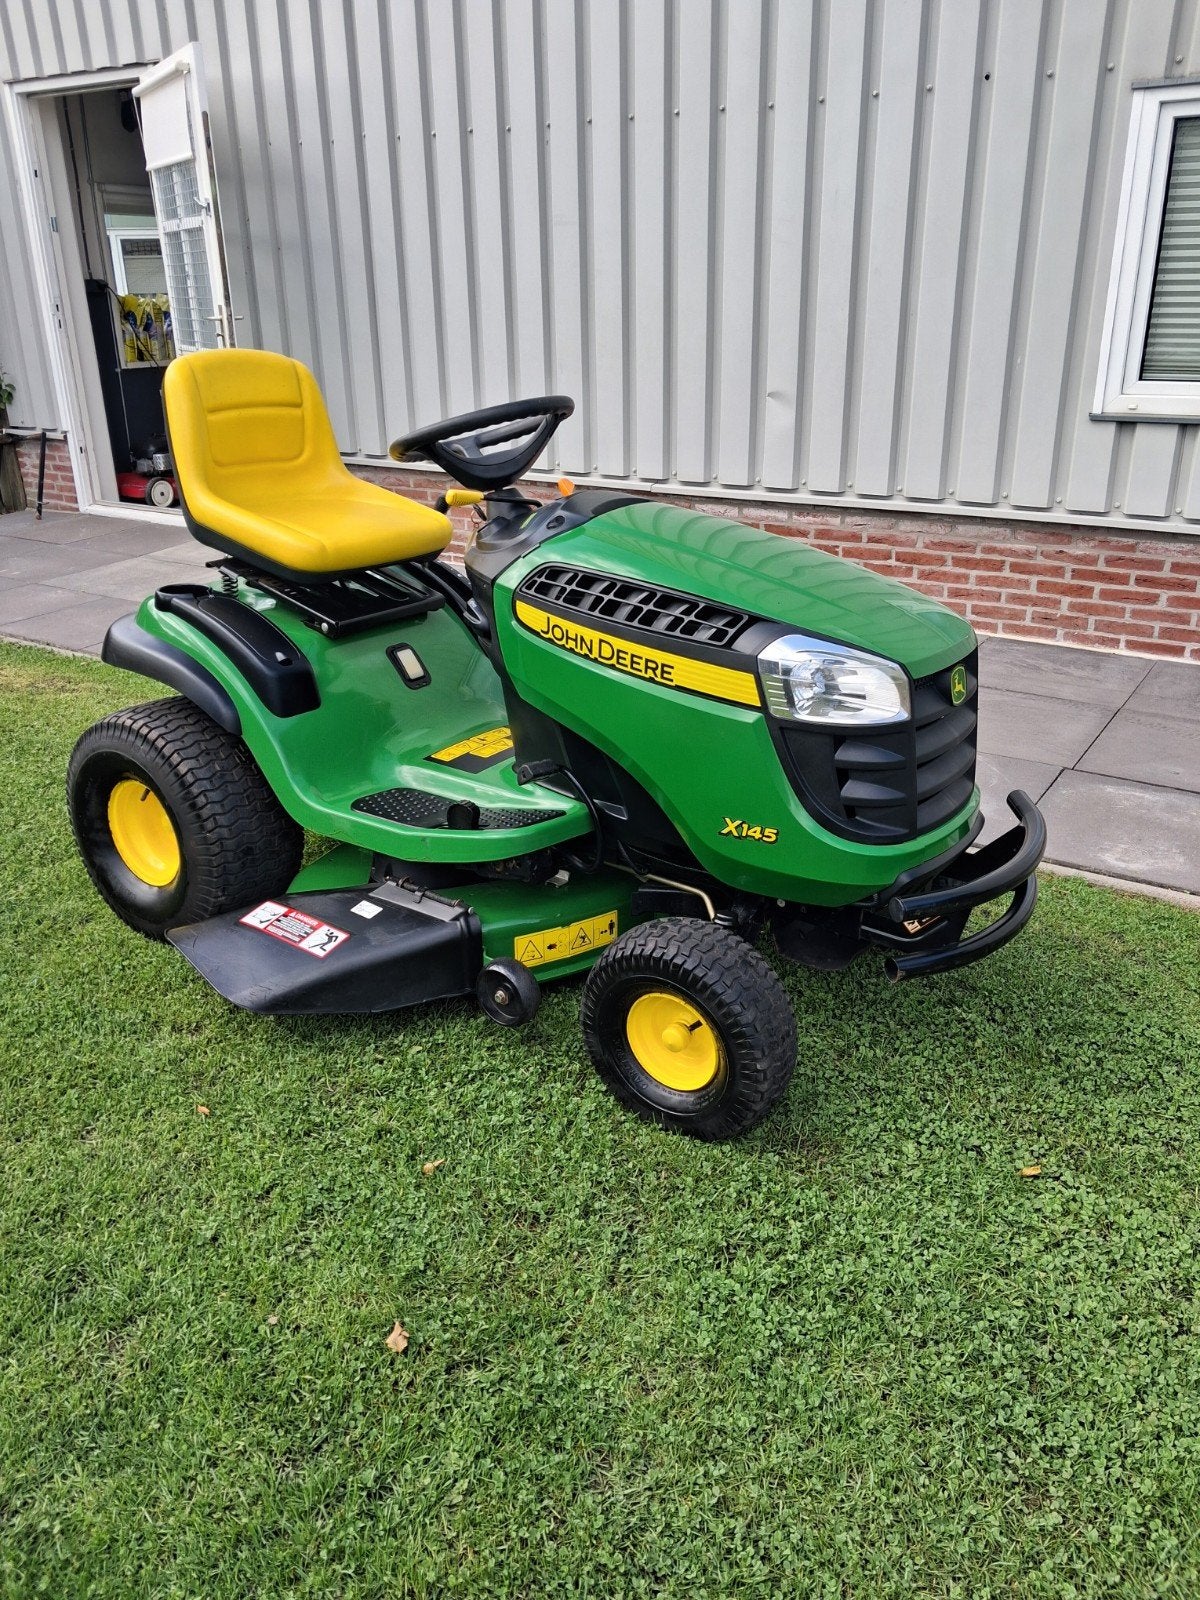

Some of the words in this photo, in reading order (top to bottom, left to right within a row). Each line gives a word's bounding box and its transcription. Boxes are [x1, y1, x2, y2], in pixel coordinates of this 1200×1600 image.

[540, 616, 594, 656] JOHN
[599, 639, 675, 683] DEERE
[719, 817, 778, 843] X145
